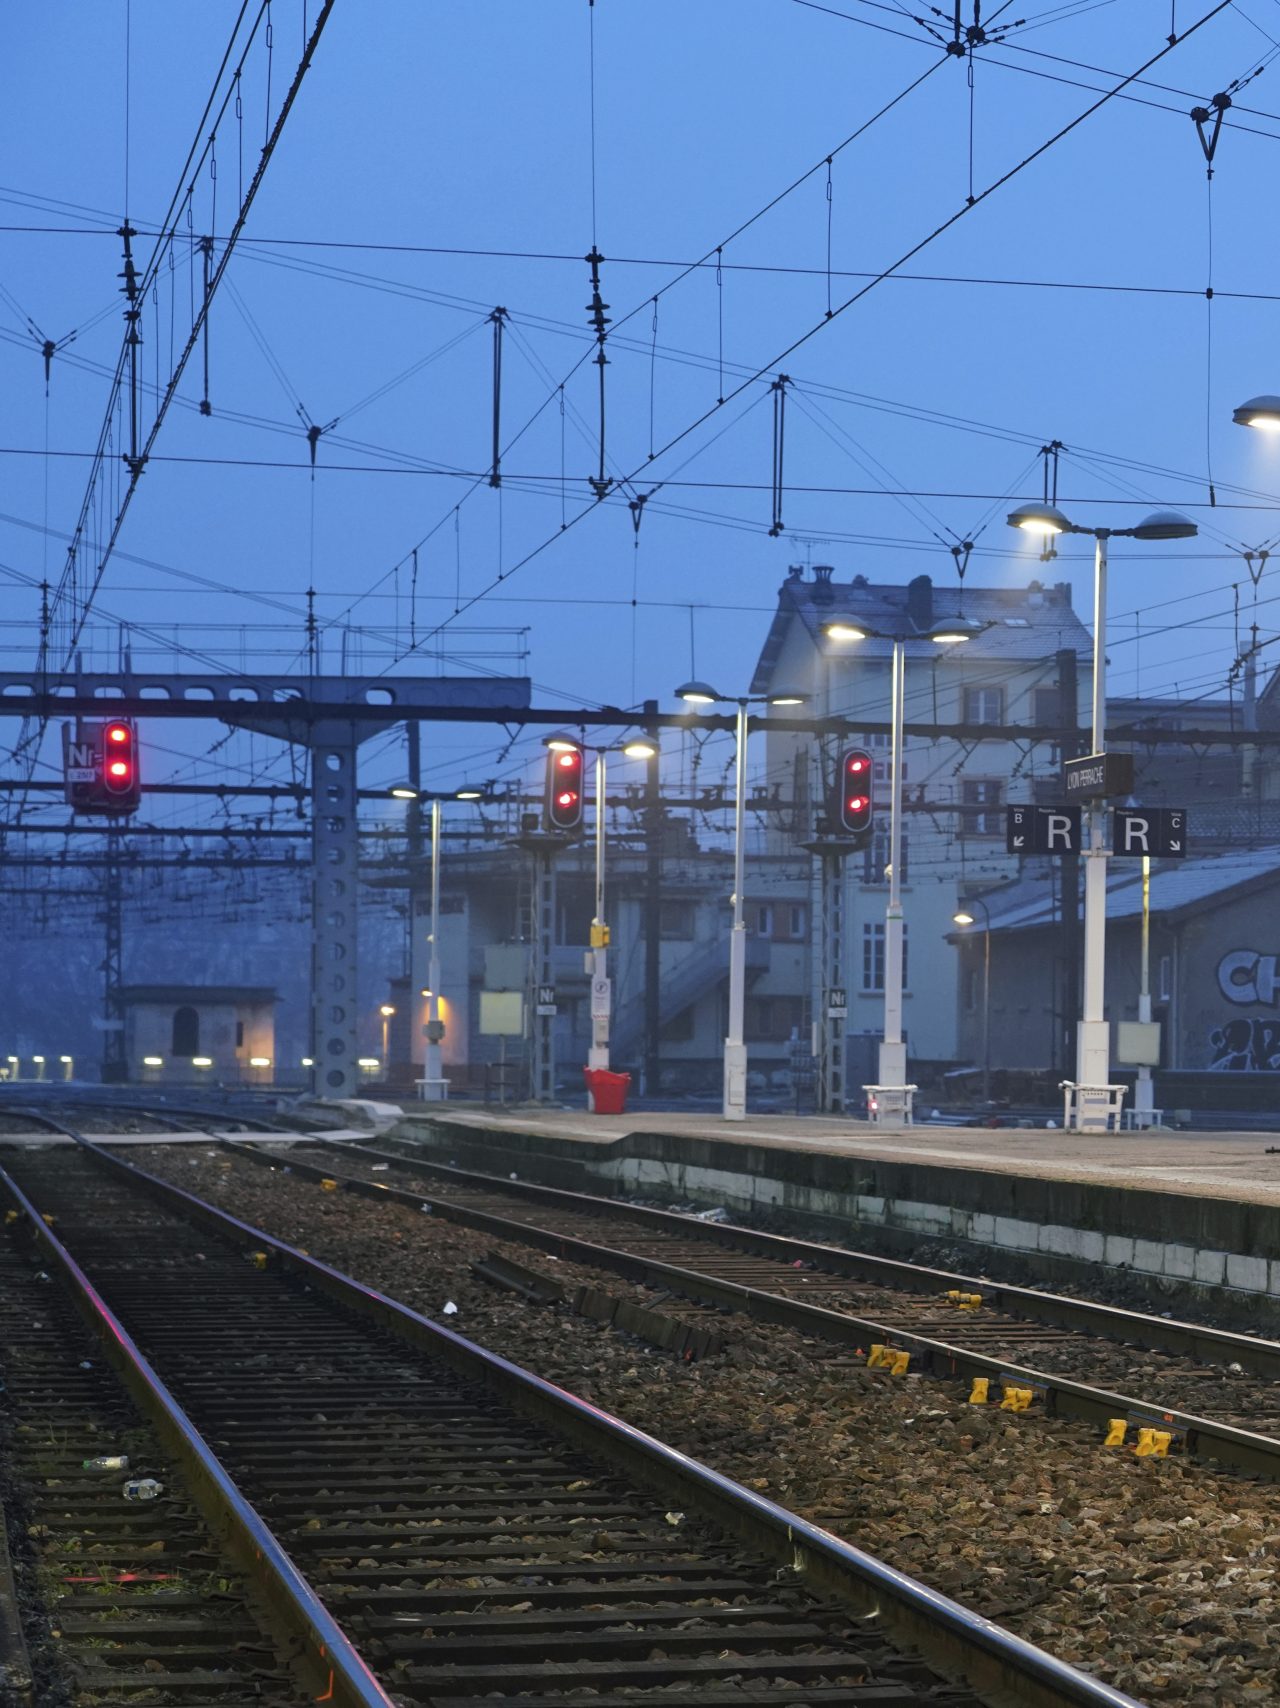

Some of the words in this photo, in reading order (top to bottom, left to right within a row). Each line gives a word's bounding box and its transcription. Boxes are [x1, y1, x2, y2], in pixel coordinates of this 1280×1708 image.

[68, 744, 95, 767] Nr
[1067, 771, 1080, 790] LYON
[1079, 765, 1104, 787] PERRACHE
[1014, 813, 1023, 824] B
[1171, 817, 1181, 828] C
[1047, 815, 1072, 849] R
[1125, 817, 1149, 851] R
